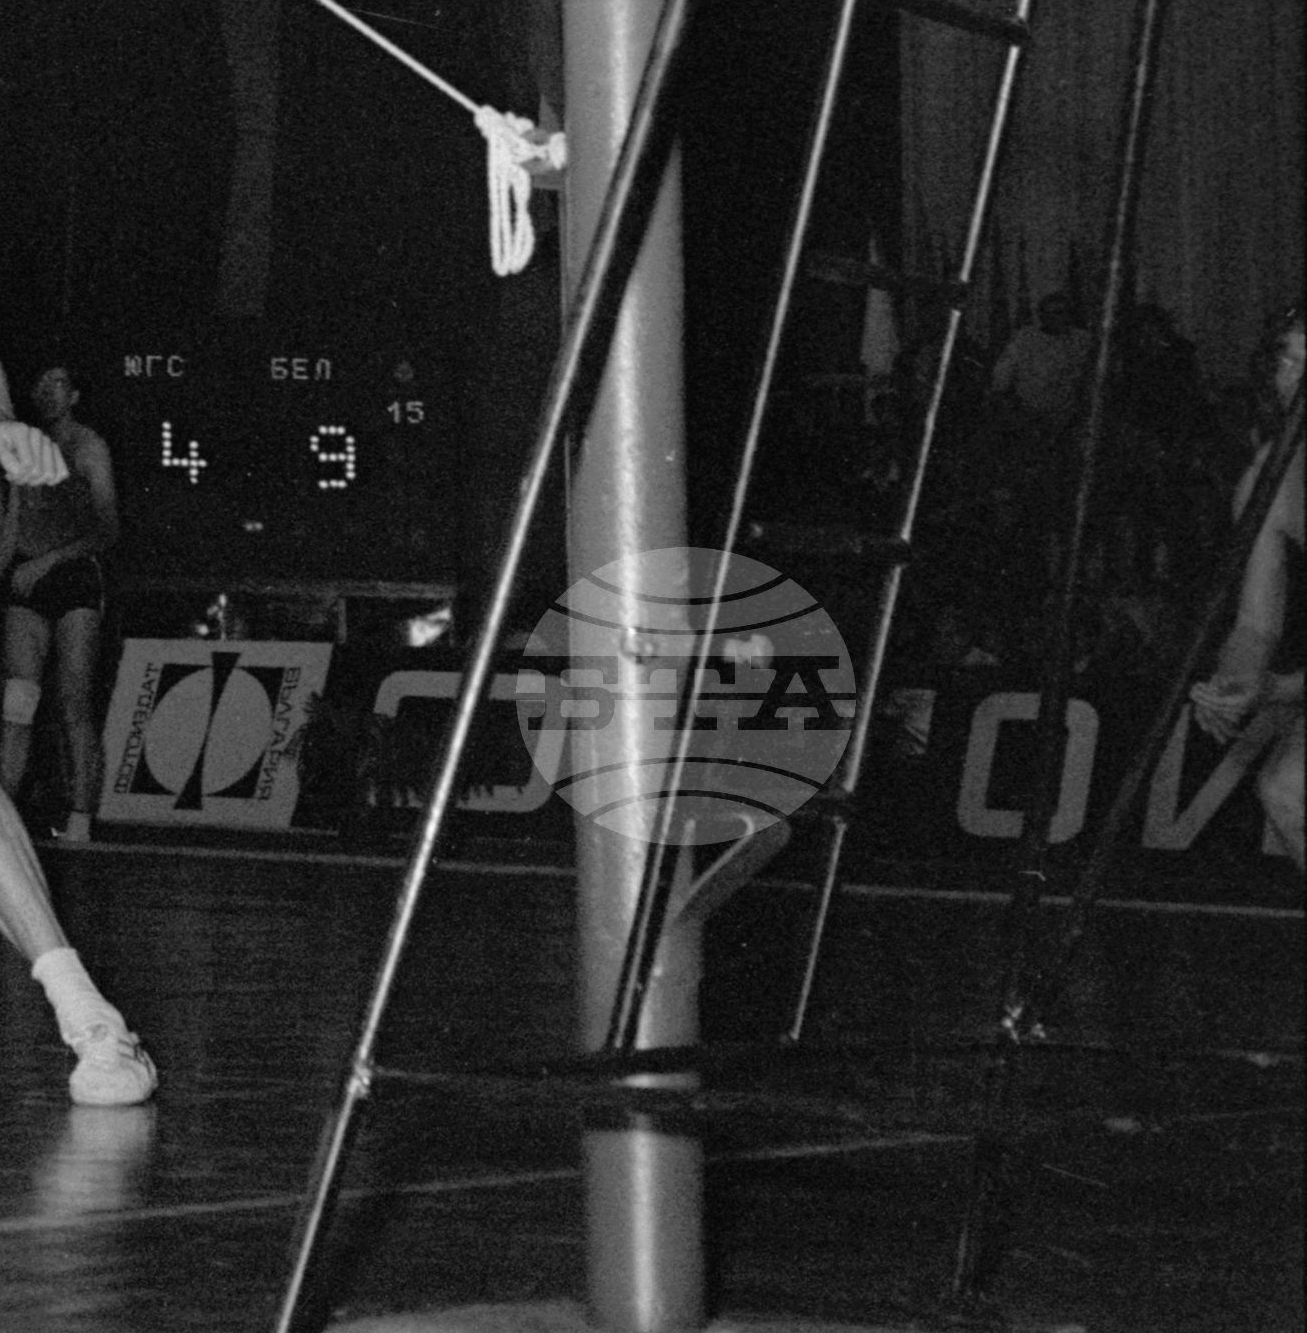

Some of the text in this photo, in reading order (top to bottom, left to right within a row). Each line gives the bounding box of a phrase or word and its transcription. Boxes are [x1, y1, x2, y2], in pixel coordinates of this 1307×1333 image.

[123, 354, 333, 381] ЮГС БЕЛ
[386, 400, 426, 425] 15
[161, 420, 357, 490] 4 9
